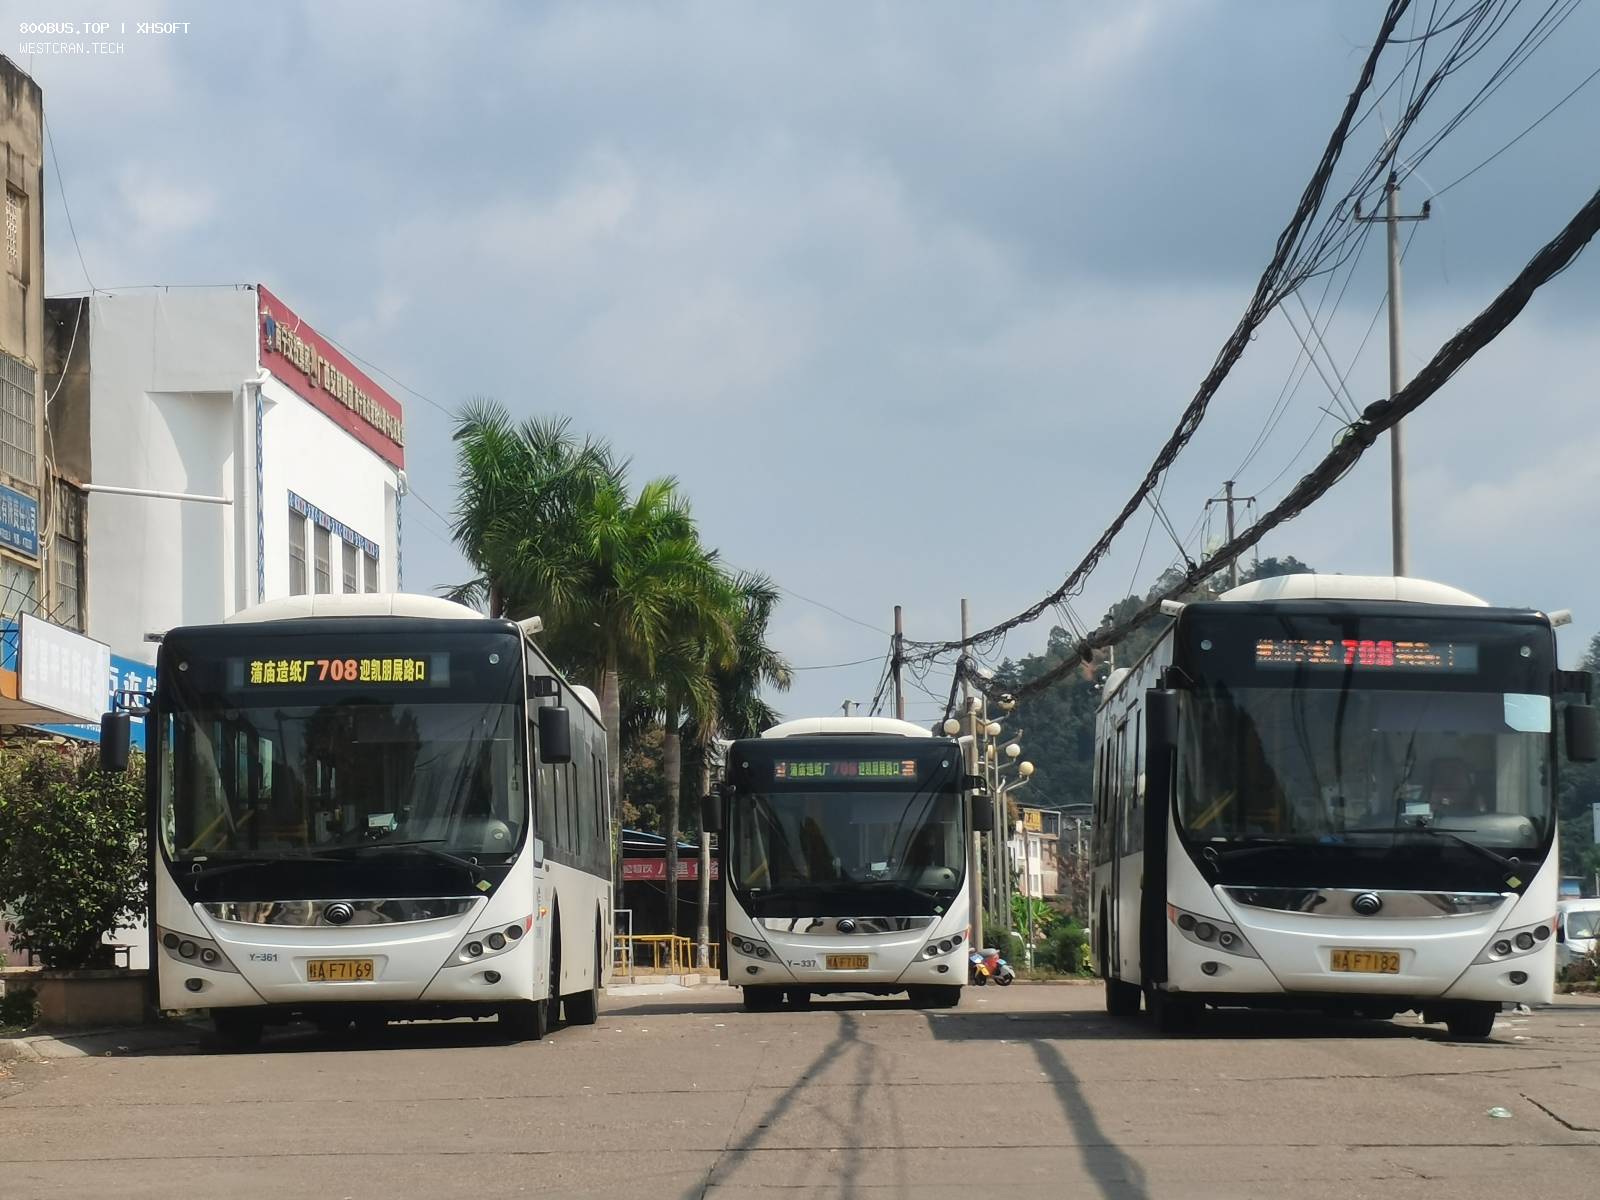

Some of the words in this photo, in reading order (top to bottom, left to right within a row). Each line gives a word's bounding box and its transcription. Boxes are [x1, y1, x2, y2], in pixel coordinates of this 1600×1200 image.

[250, 660, 315, 683] 蒲庙造纸厂
[317, 659, 358, 681] 708
[359, 658, 425, 681] 迎凯朋展路口
[786, 959, 816, 967] Y-337
